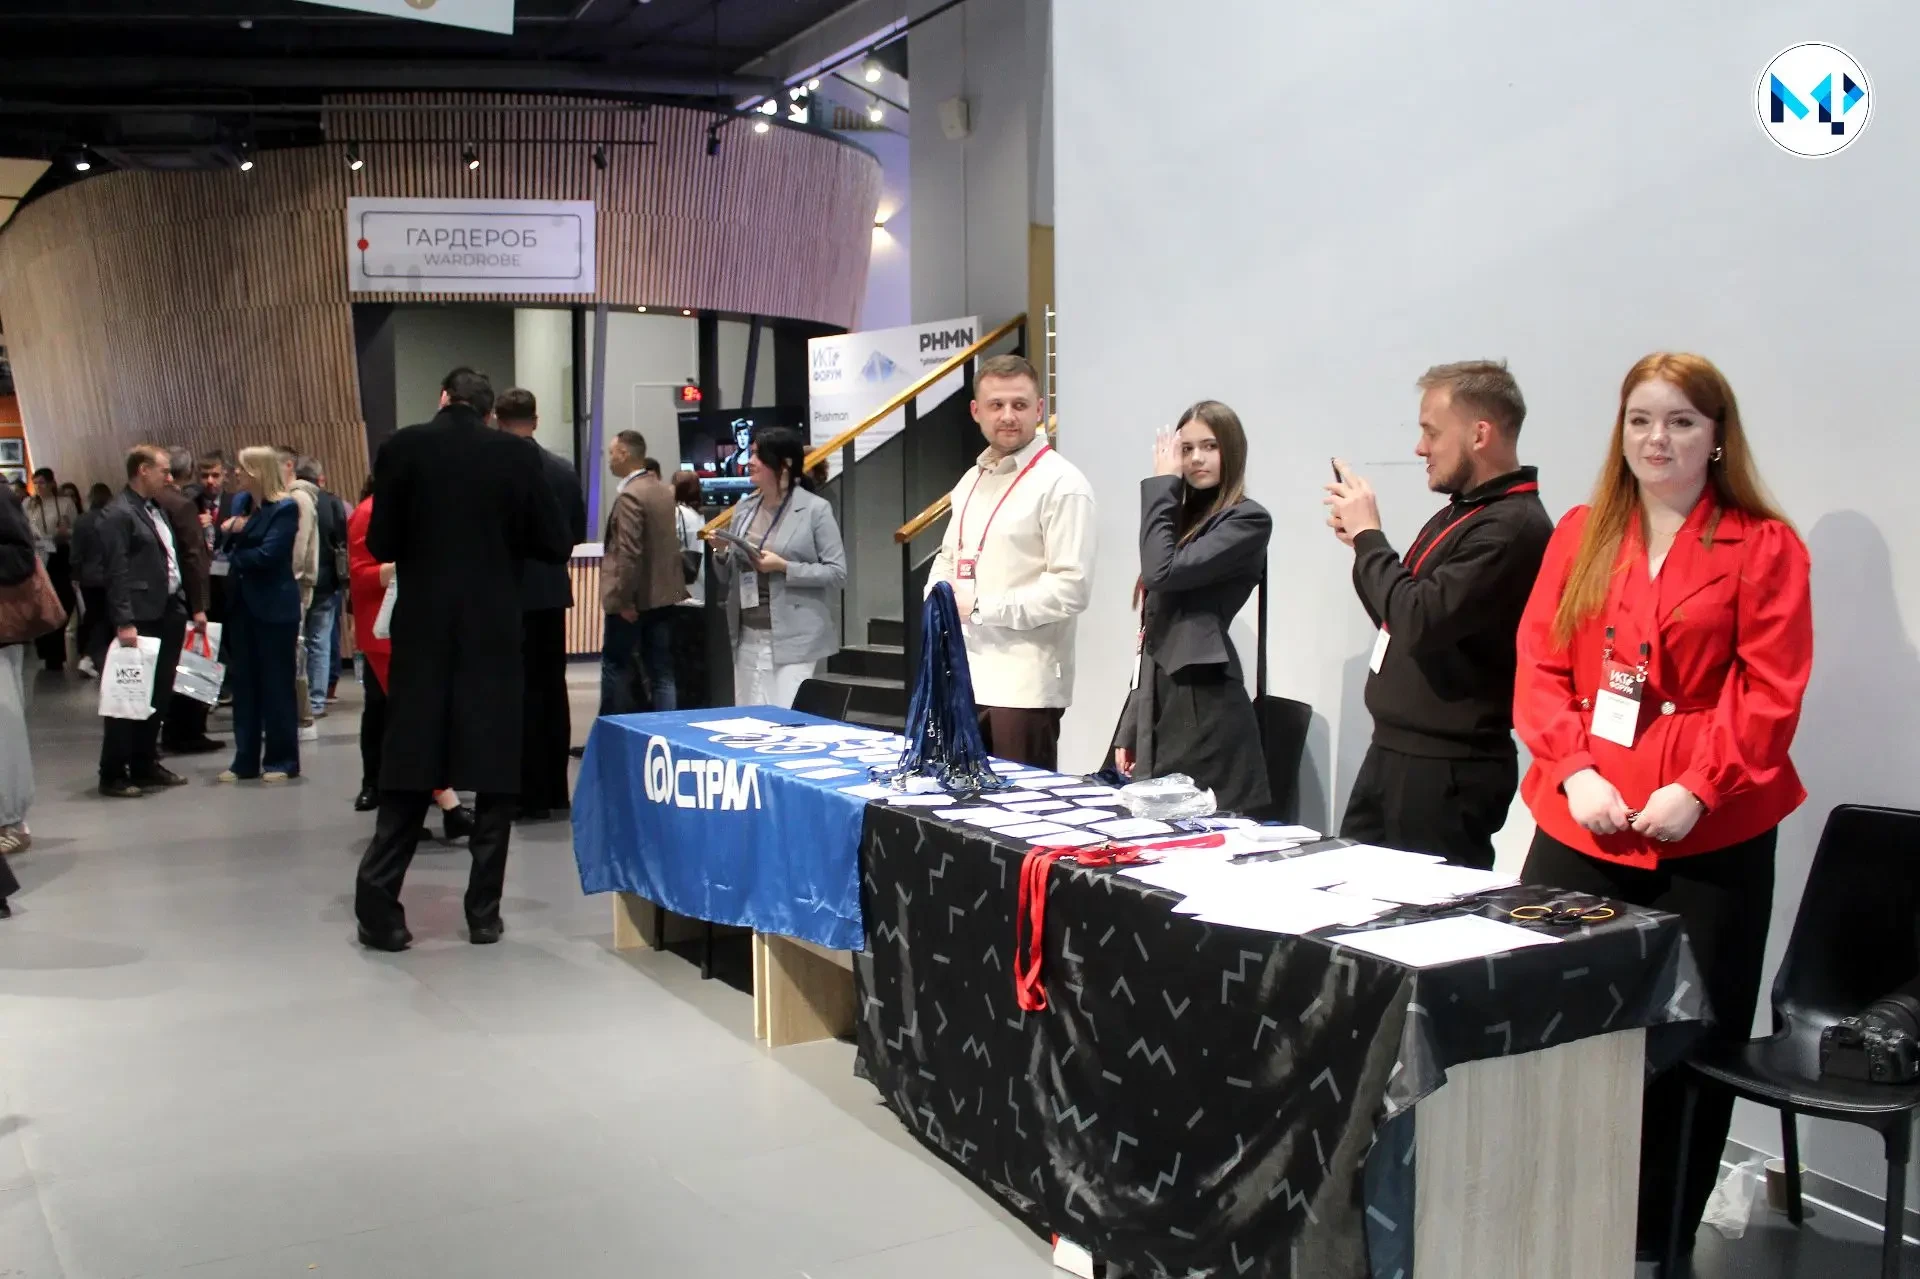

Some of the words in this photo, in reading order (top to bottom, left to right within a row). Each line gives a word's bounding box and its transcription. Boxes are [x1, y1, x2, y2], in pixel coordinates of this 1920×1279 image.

[406, 227, 538, 250] ГАРДЕРОБ
[424, 253, 521, 268] WARDROBE
[920, 327, 973, 352] PHMN
